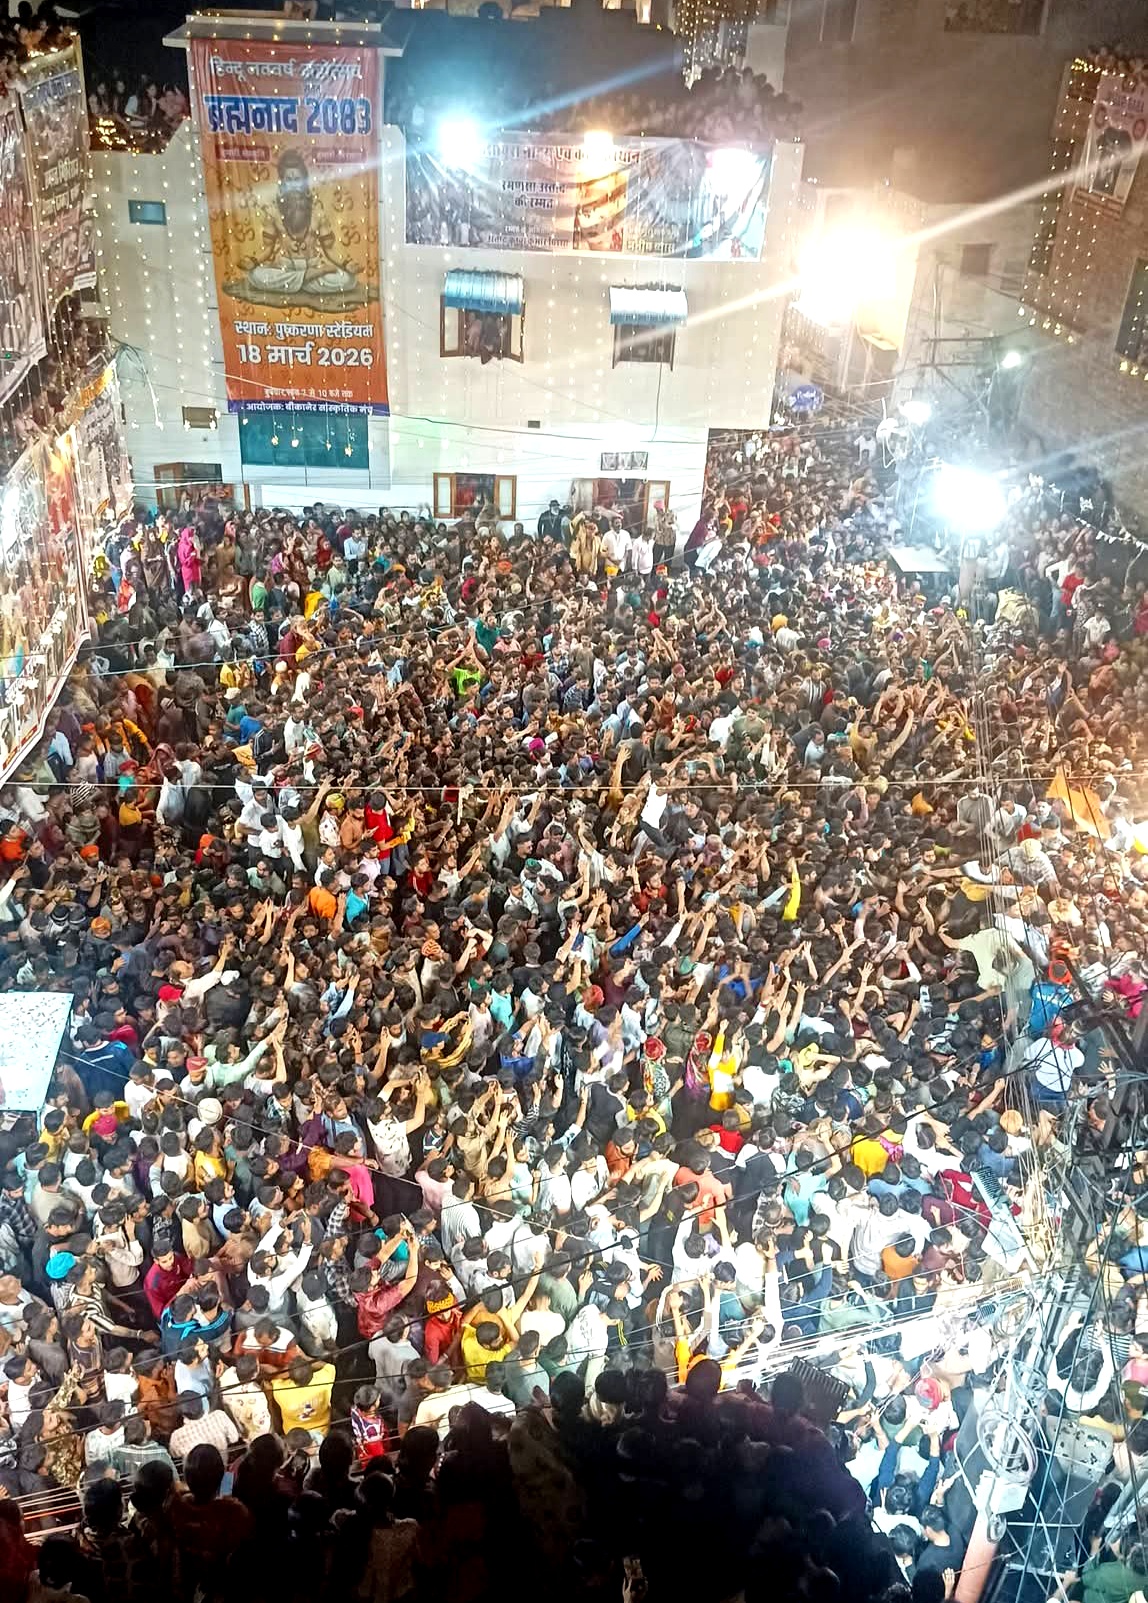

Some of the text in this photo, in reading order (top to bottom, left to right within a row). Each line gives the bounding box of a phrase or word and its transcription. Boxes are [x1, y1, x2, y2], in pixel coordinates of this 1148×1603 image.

[246, 58, 297, 79] नववर्ष
[203, 95, 372, 135] ब्रह्मनाद 2083
[234, 320, 374, 341] स्थान: पुष्करणा स्टेडियम
[238, 341, 374, 367] 18 मार्च 2026
[318, 389, 327, 398] 10
[285, 401, 318, 413] बीकानेर
